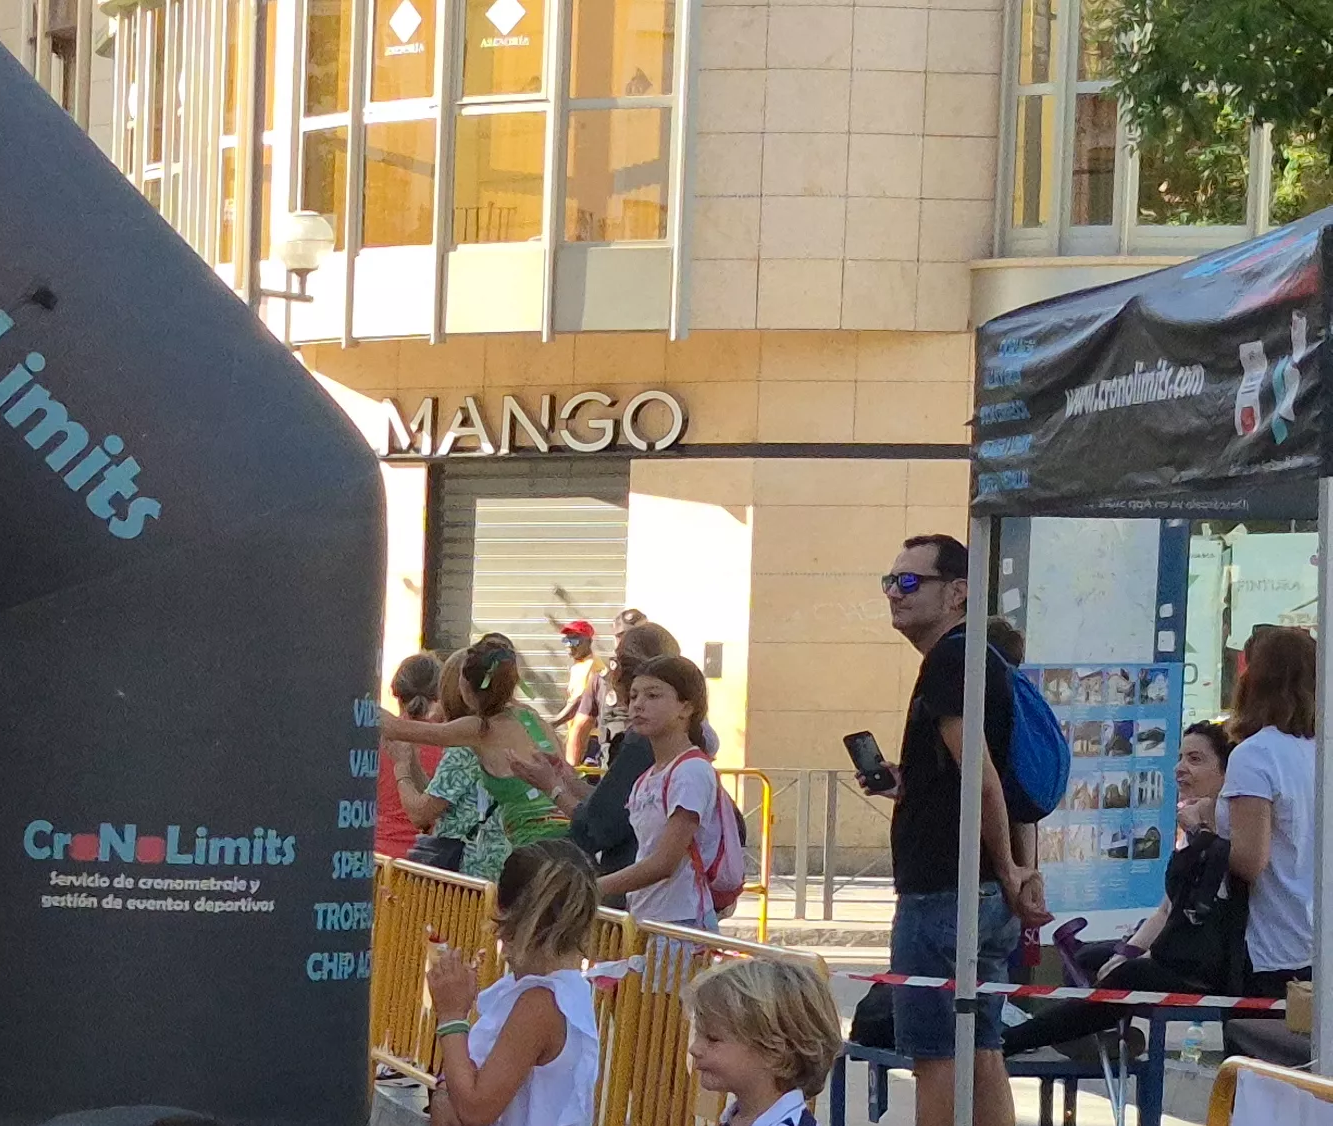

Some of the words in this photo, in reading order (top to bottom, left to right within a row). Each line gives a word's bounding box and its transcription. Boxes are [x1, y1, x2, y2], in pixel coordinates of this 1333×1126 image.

[378, 390, 683, 456] MANGO
[50, 871, 110, 889] Servicio
[113, 873, 134, 889] de
[137, 876, 247, 895] cronometraje
[250, 879, 261, 893] y
[41, 893, 98, 909] gestión
[102, 893, 122, 910] de
[126, 896, 190, 911] eventos
[194, 896, 275, 913] deportivos
[306, 952, 354, 980] CHIP
